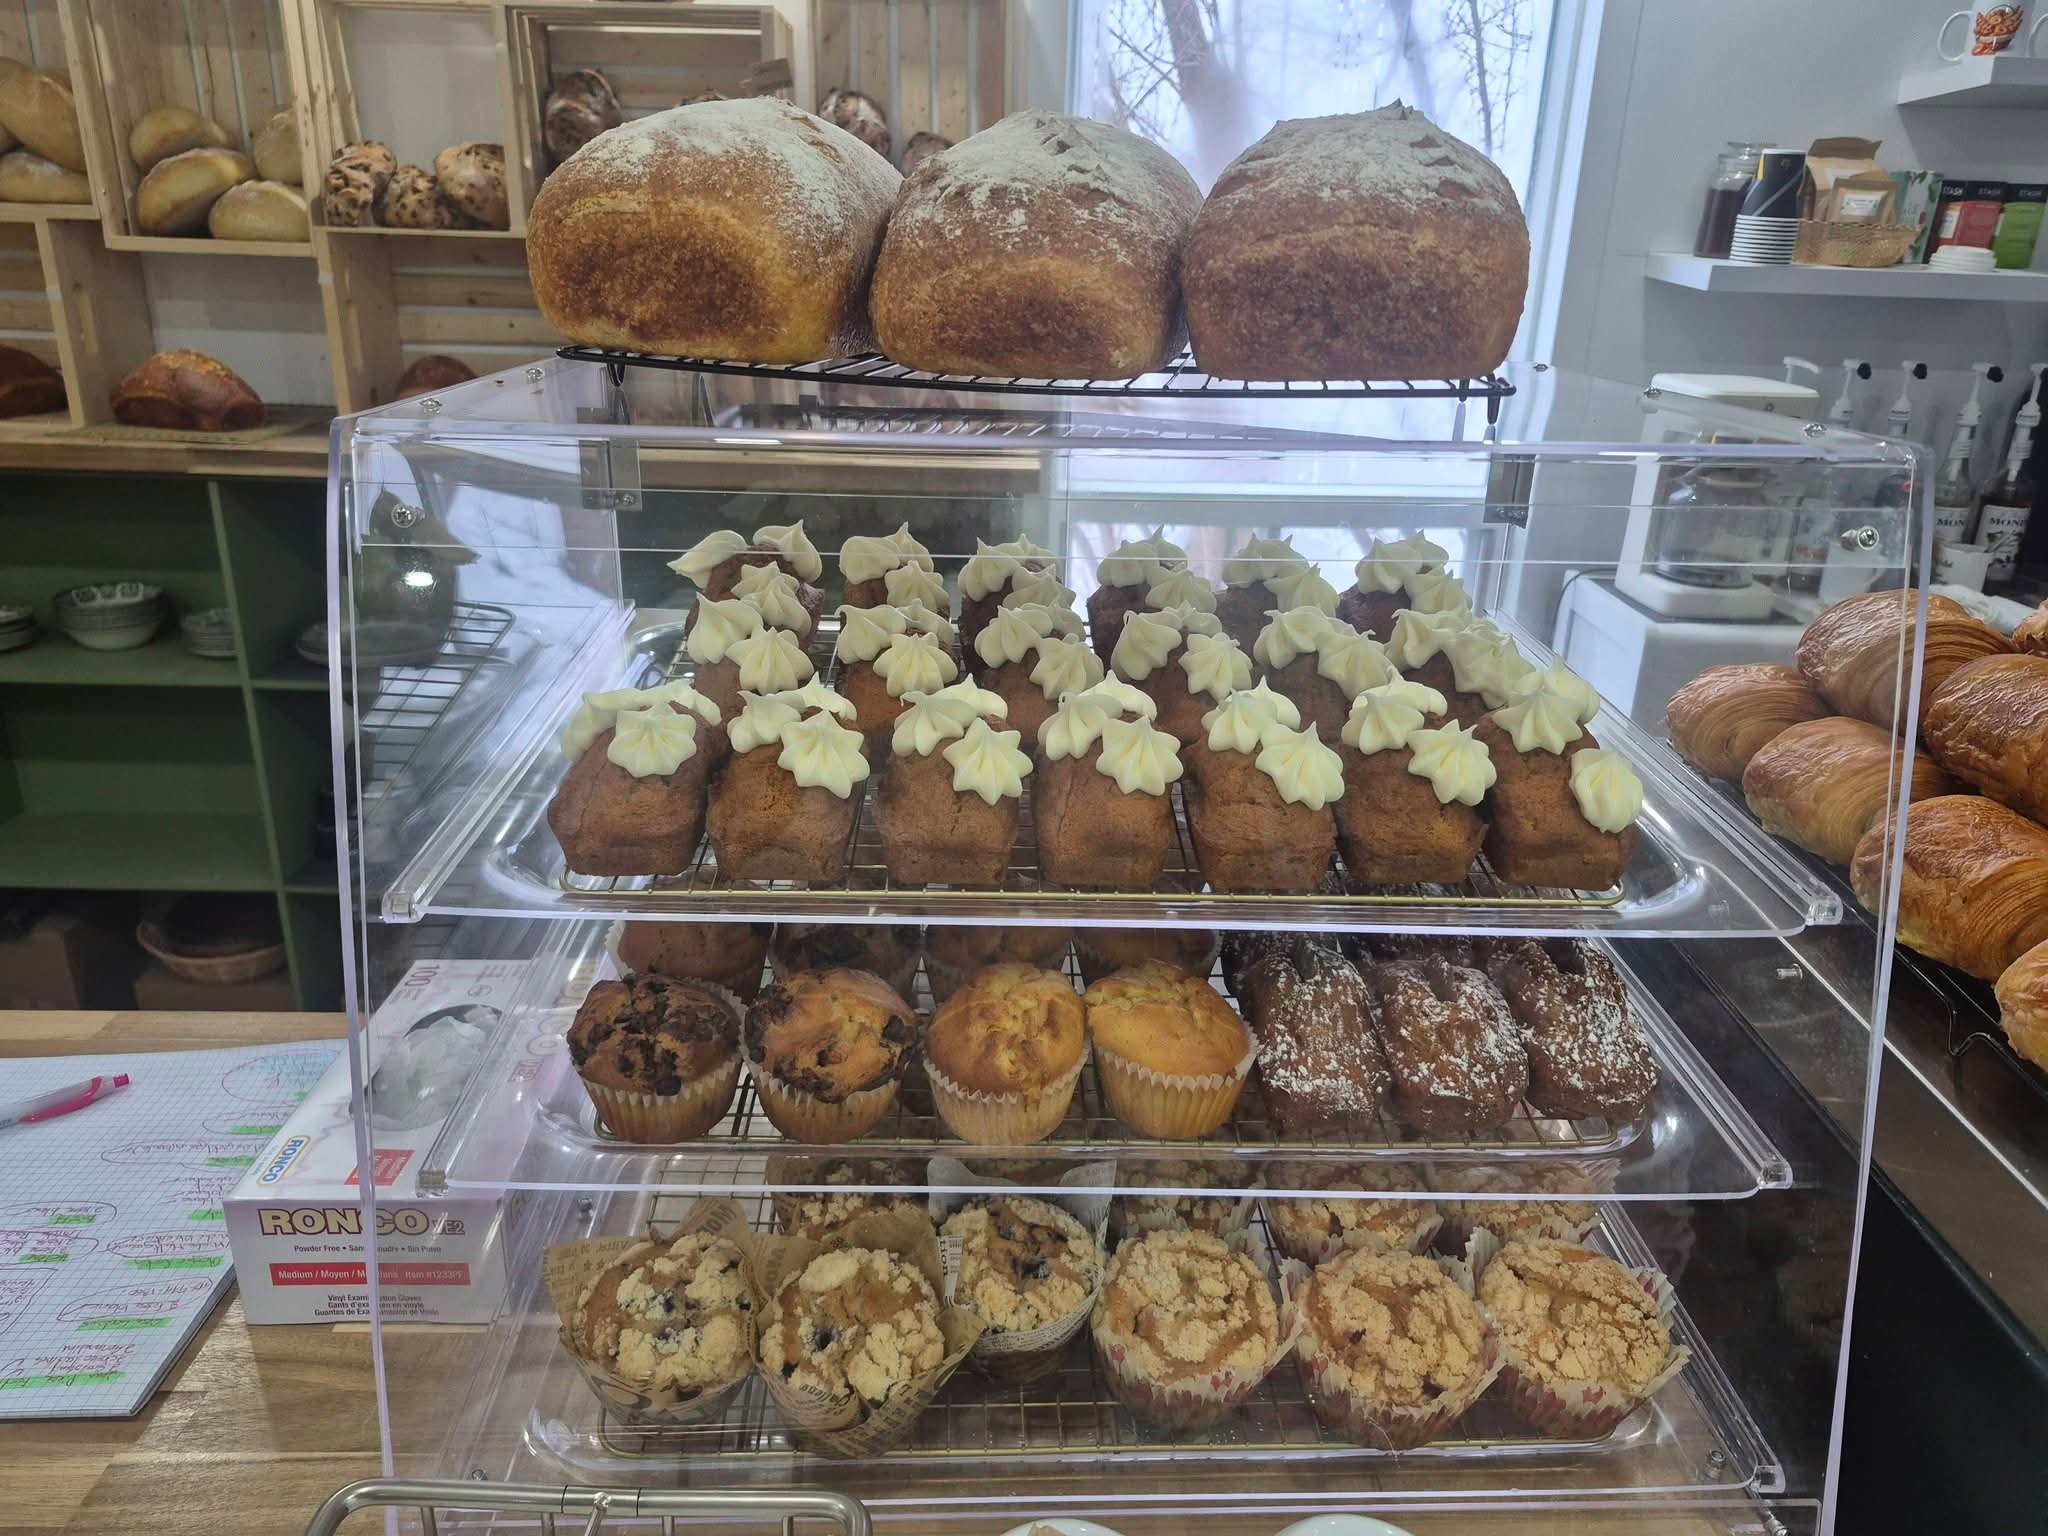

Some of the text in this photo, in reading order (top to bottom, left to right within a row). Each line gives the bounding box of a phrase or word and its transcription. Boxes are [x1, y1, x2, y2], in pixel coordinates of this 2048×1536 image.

[1936, 518, 1967, 527] MON
[404, 963, 440, 987] 100
[261, 1138, 305, 1184] RONCO
[258, 1208, 430, 1235] RONCO
[293, 1244, 322, 1253] Powder
[323, 1244, 341, 1252] Free
[407, 1246, 420, 1254] Sin
[277, 1270, 314, 1279] Medium
[320, 1270, 350, 1280] Moyen
[404, 1271, 425, 1280] Item
[327, 1294, 346, 1303] Vinyl
[327, 1301, 349, 1309] Gants
[314, 1309, 345, 1317] Guantes
